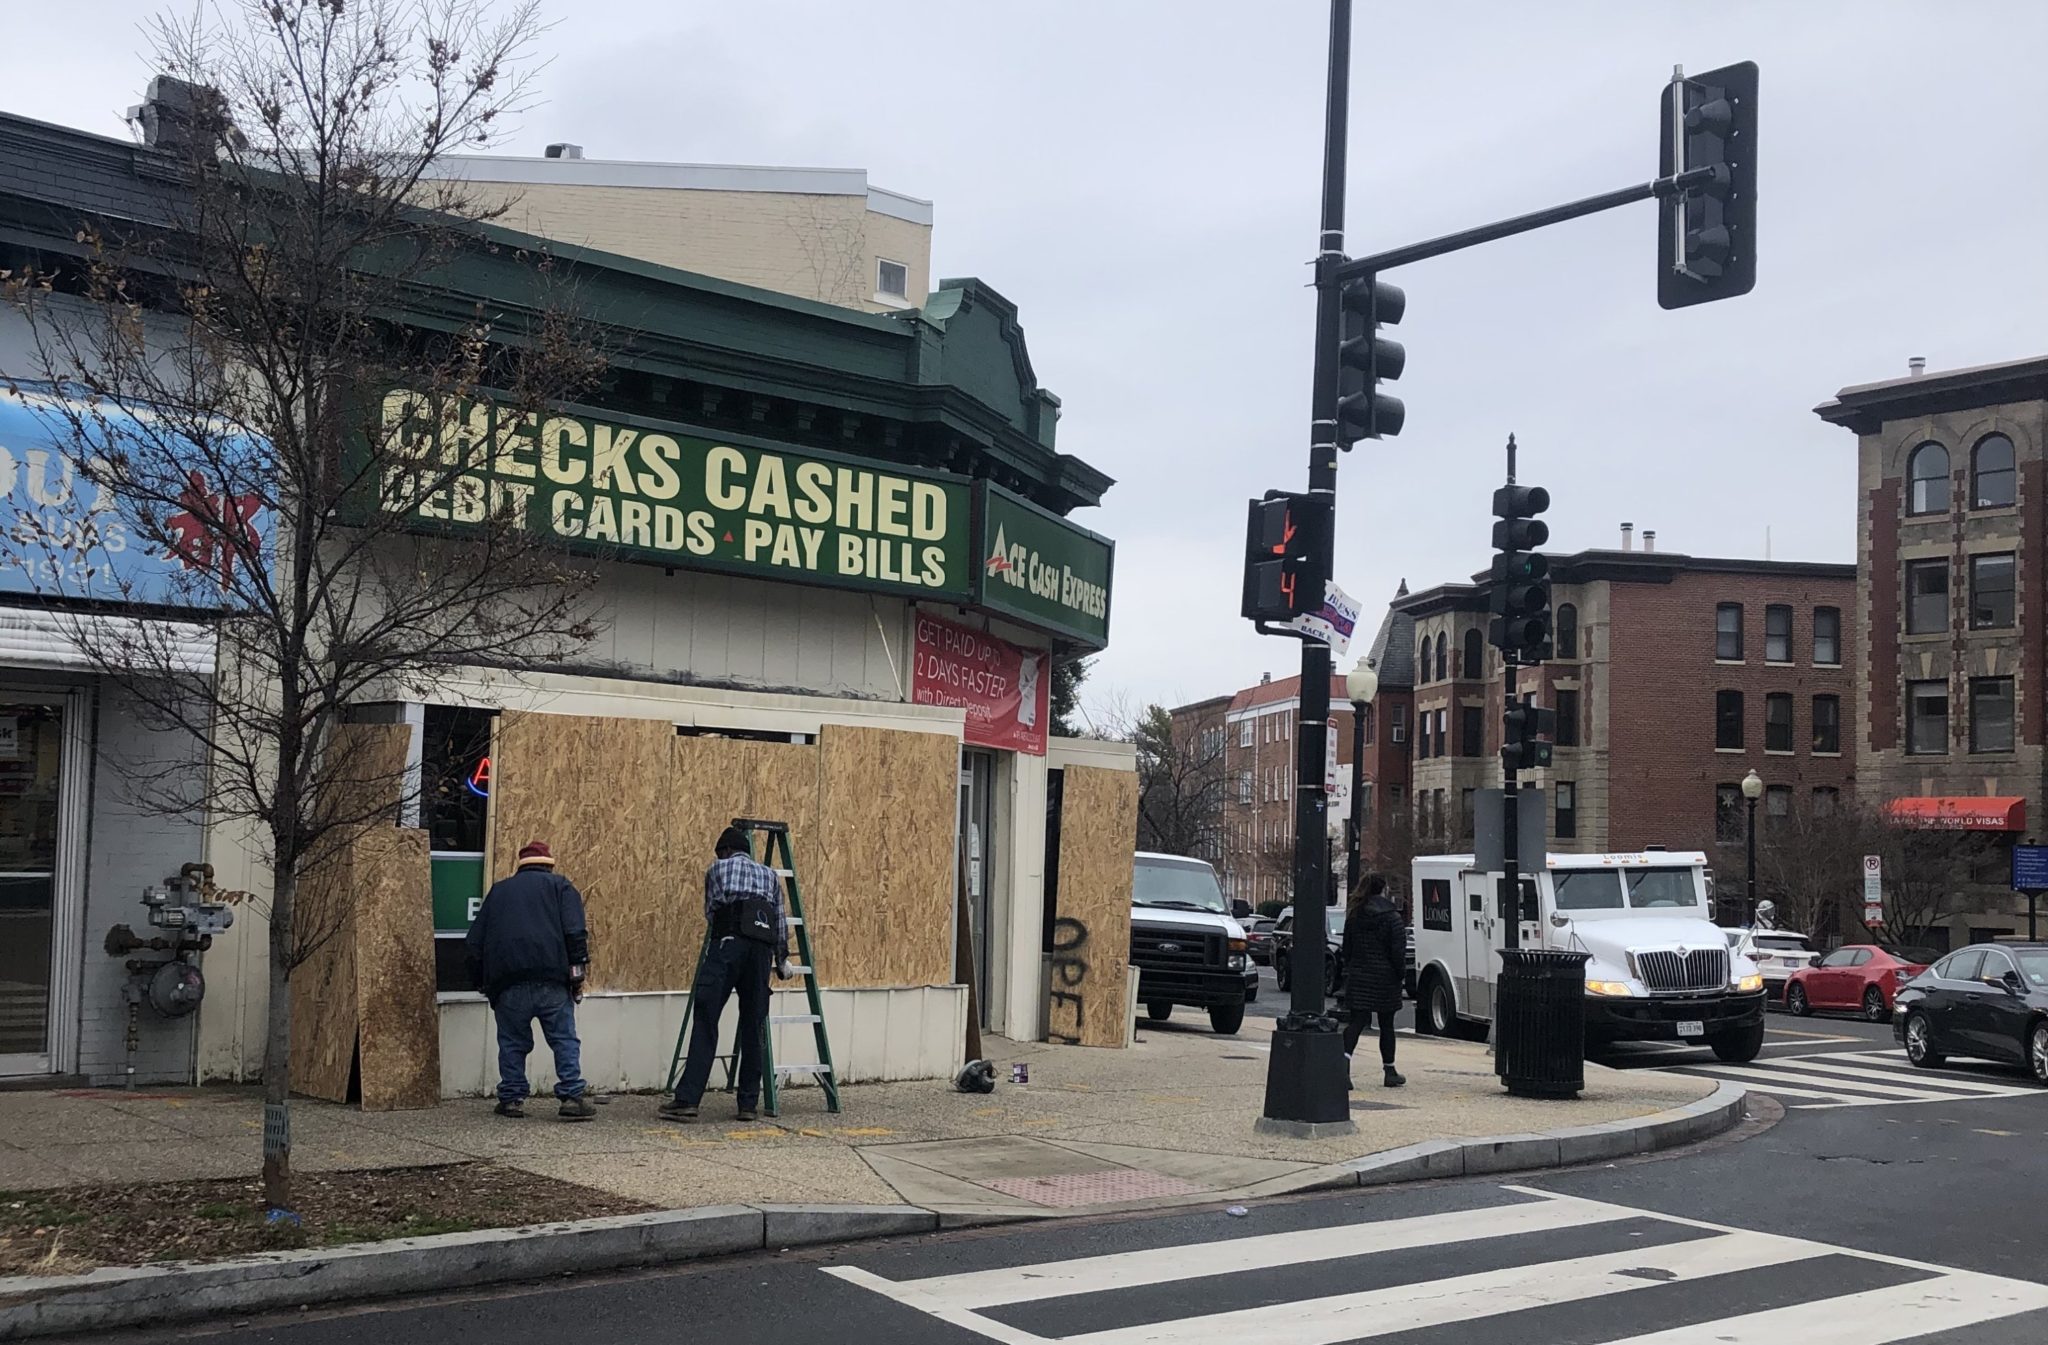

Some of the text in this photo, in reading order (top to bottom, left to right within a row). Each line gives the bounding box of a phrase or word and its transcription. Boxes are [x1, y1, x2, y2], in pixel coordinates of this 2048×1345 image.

[381, 387, 948, 542] CHECKS CASHED
[380, 465, 947, 588] DEBIT CARDS PAY BILLS
[986, 521, 1107, 620] ACE CASH EXPRESS
[1281, 571, 1296, 609] 4
[917, 619, 942, 647] GET
[945, 628, 975, 658] PAID
[978, 644, 992, 662] UP
[916, 686, 933, 704] with
[917, 652, 1007, 700] 2 DAYS FASTER
[1976, 817, 2005, 826] VISAS
